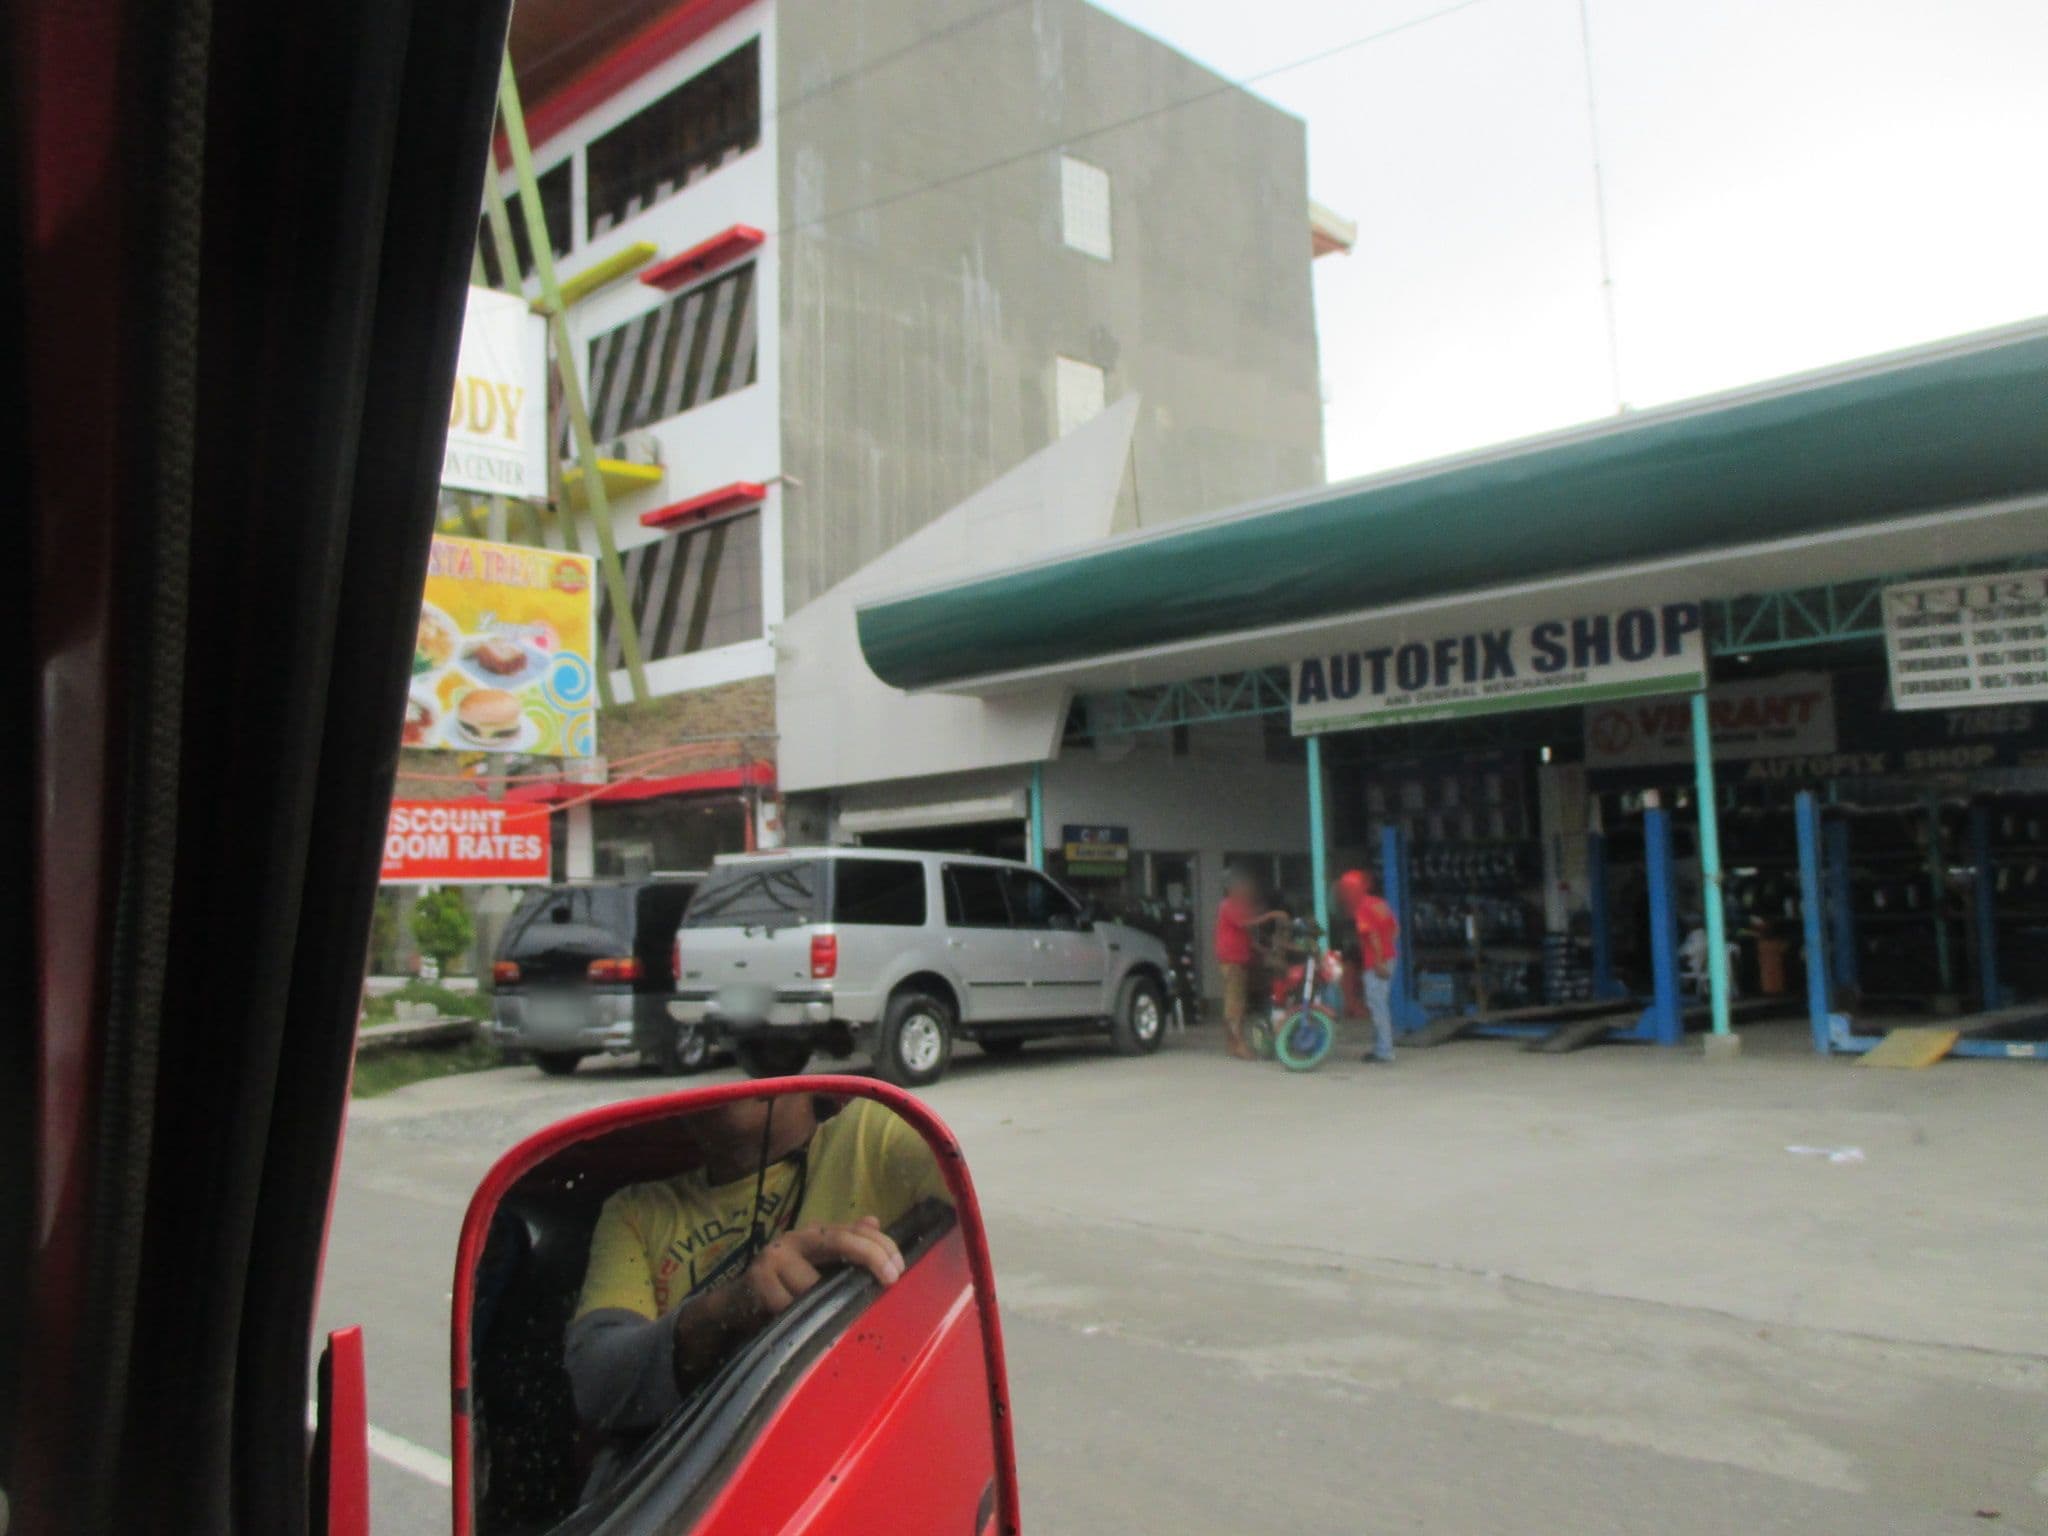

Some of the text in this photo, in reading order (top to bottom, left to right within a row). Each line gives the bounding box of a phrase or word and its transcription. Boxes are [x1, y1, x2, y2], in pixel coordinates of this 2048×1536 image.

[1297, 603, 1701, 706] AUTOFIX SHOP
[1414, 683, 1478, 703] GENERAL
[1483, 671, 1587, 695] MERCHANDISE
[1904, 744, 1997, 770] SHOP
[456, 834, 542, 861] RATES
